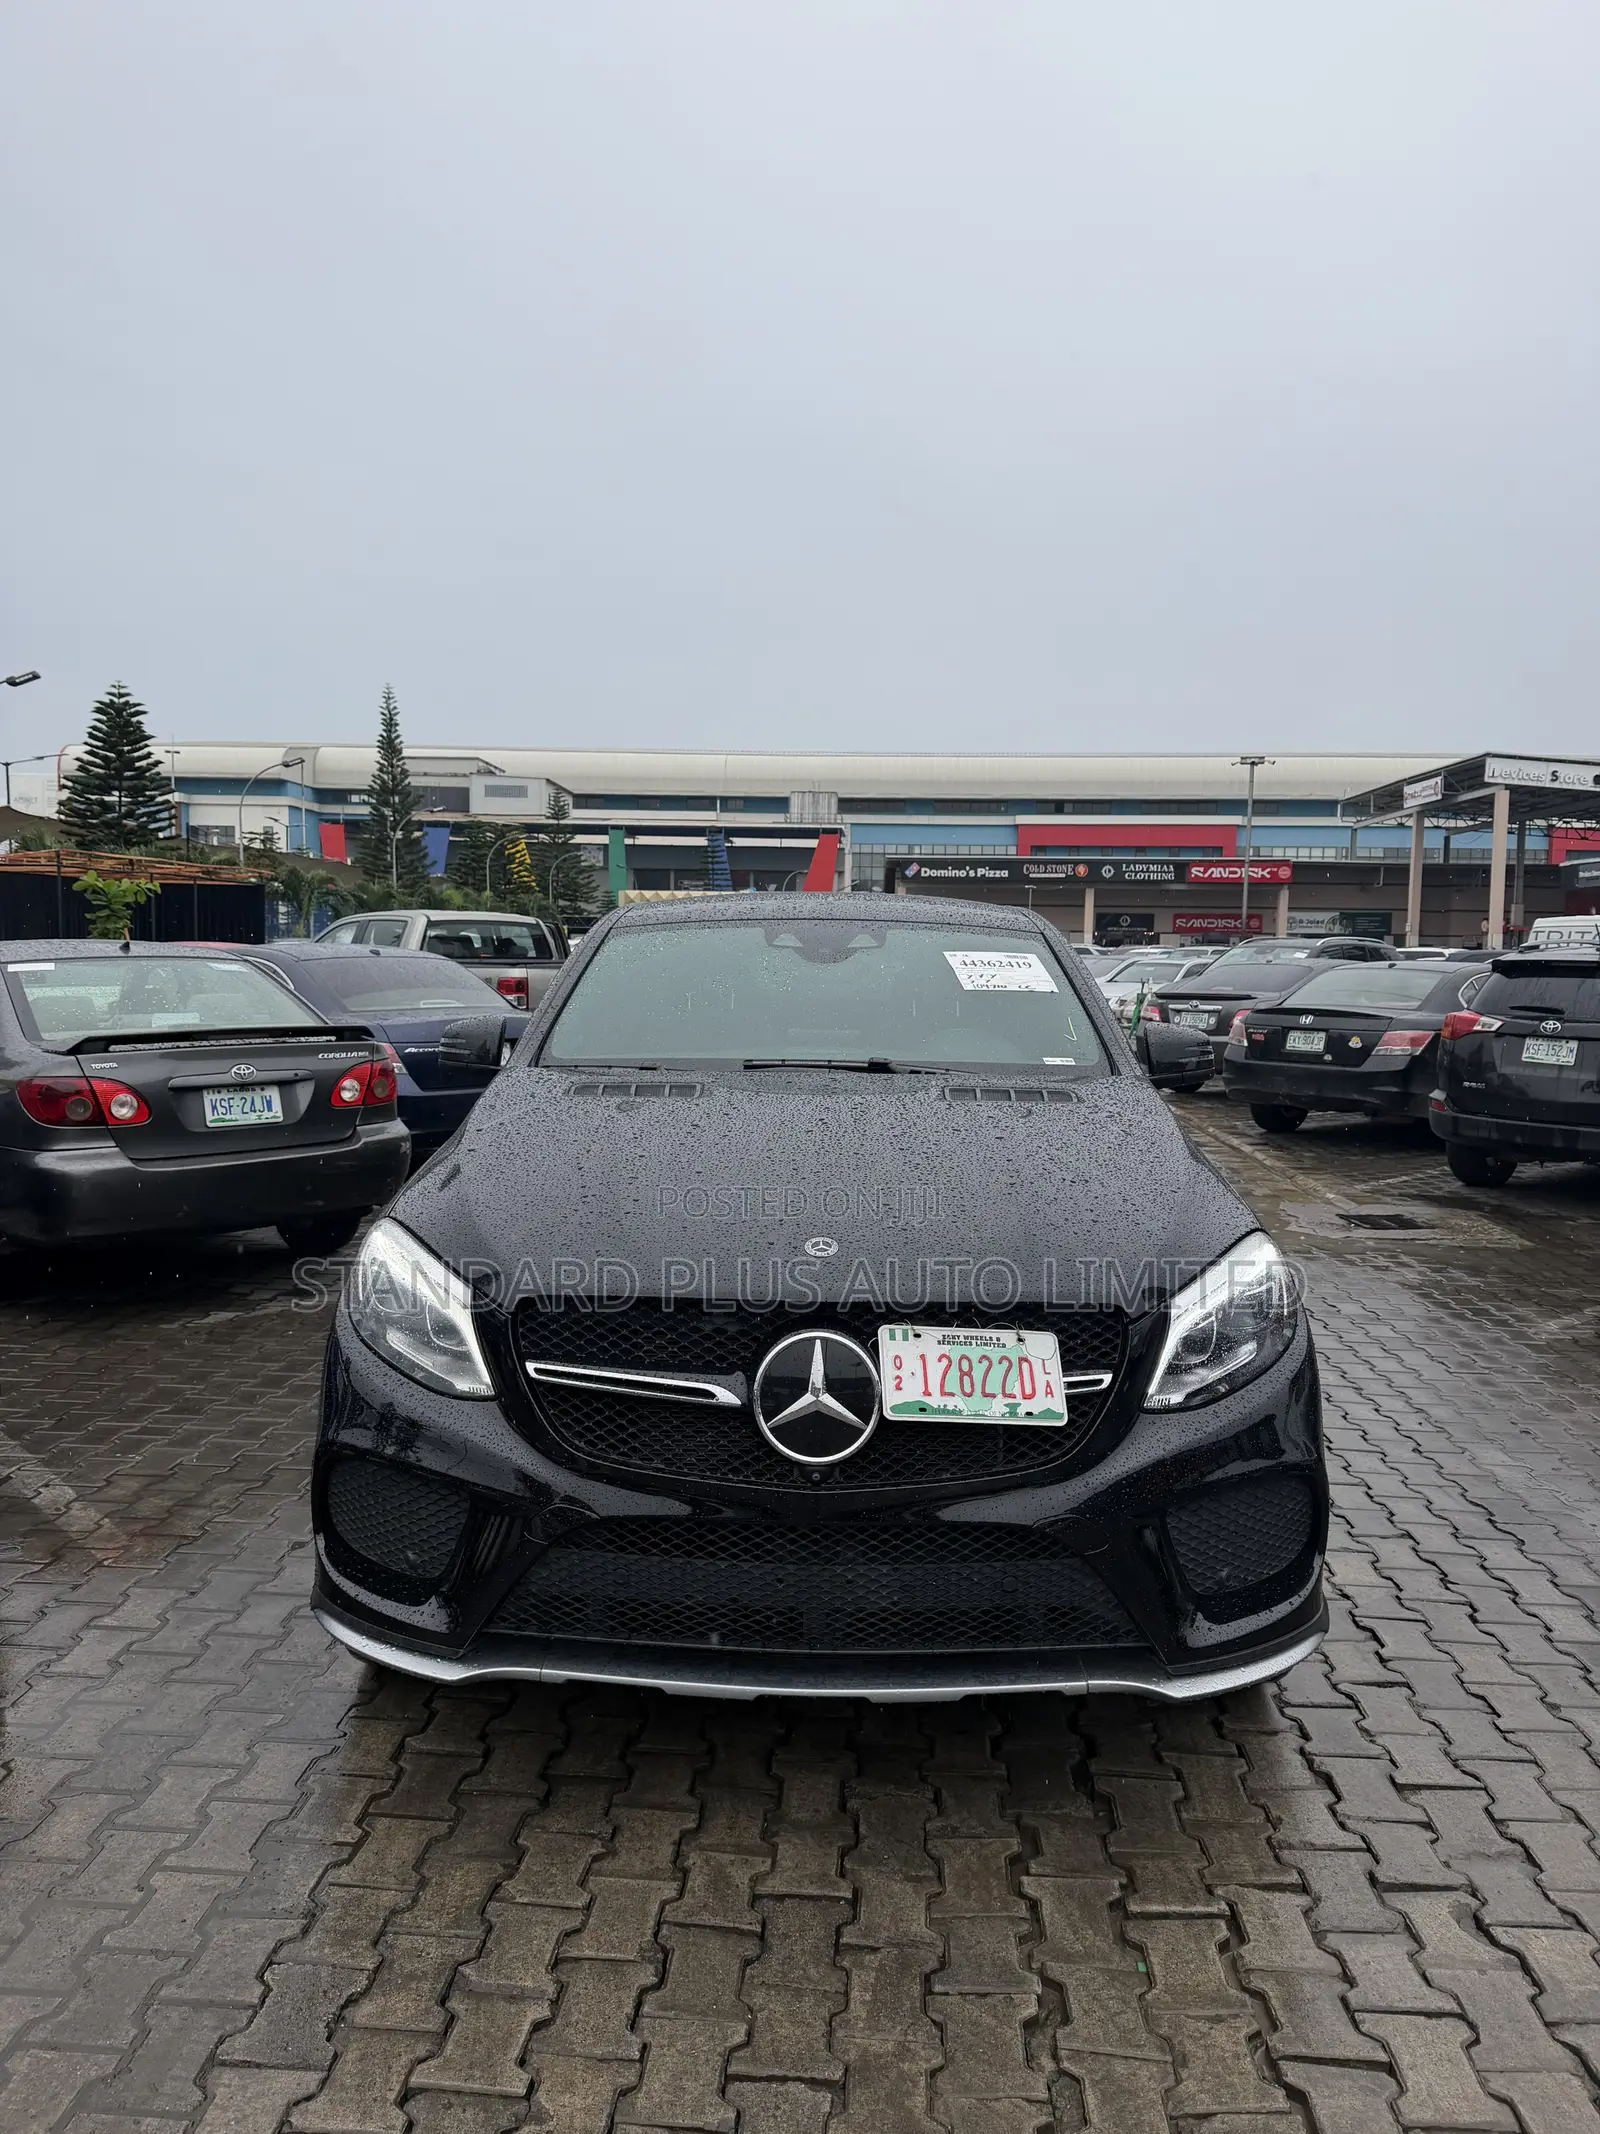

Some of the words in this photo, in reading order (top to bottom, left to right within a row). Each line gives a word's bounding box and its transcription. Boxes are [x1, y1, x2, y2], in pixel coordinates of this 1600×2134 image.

[1550, 768, 1589, 785] Store
[920, 866, 975, 878] Domino's
[977, 866, 1009, 878] Pizza
[1023, 864, 1045, 875] COLD
[1047, 864, 1074, 875] STONE
[1125, 872, 1175, 881] CLOTHING
[960, 960, 1032, 969] 44362419
[318, 1051, 358, 1059] COROLLA
[91, 1062, 118, 1070] TOYOTA
[919, 1353, 1037, 1400] 12822D
